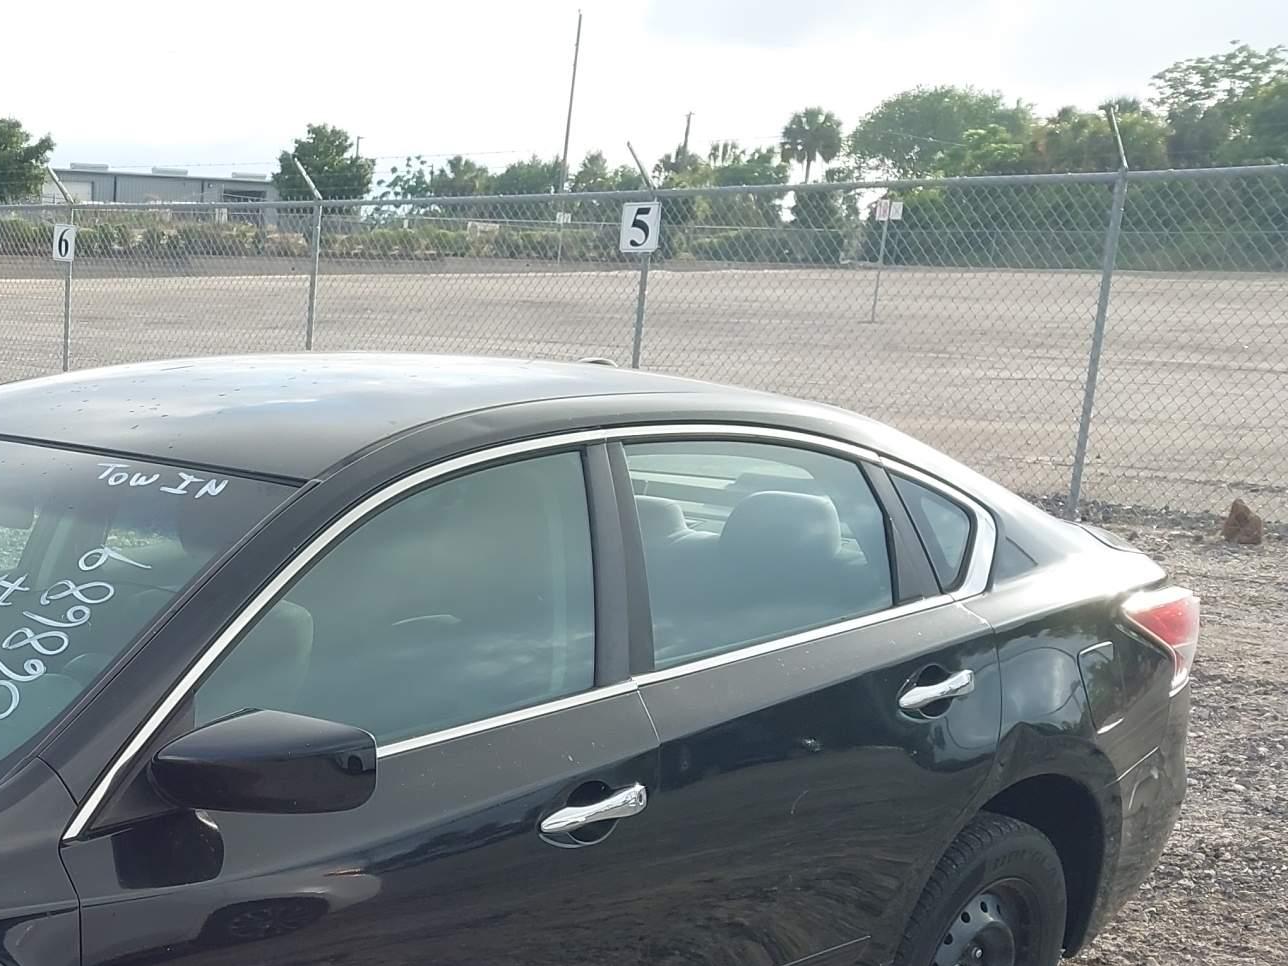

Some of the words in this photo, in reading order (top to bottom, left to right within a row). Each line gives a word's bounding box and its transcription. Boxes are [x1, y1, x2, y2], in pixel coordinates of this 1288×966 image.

[629, 207, 652, 248] 5
[58, 228, 70, 258] 6
[159, 472, 229, 499] IN
